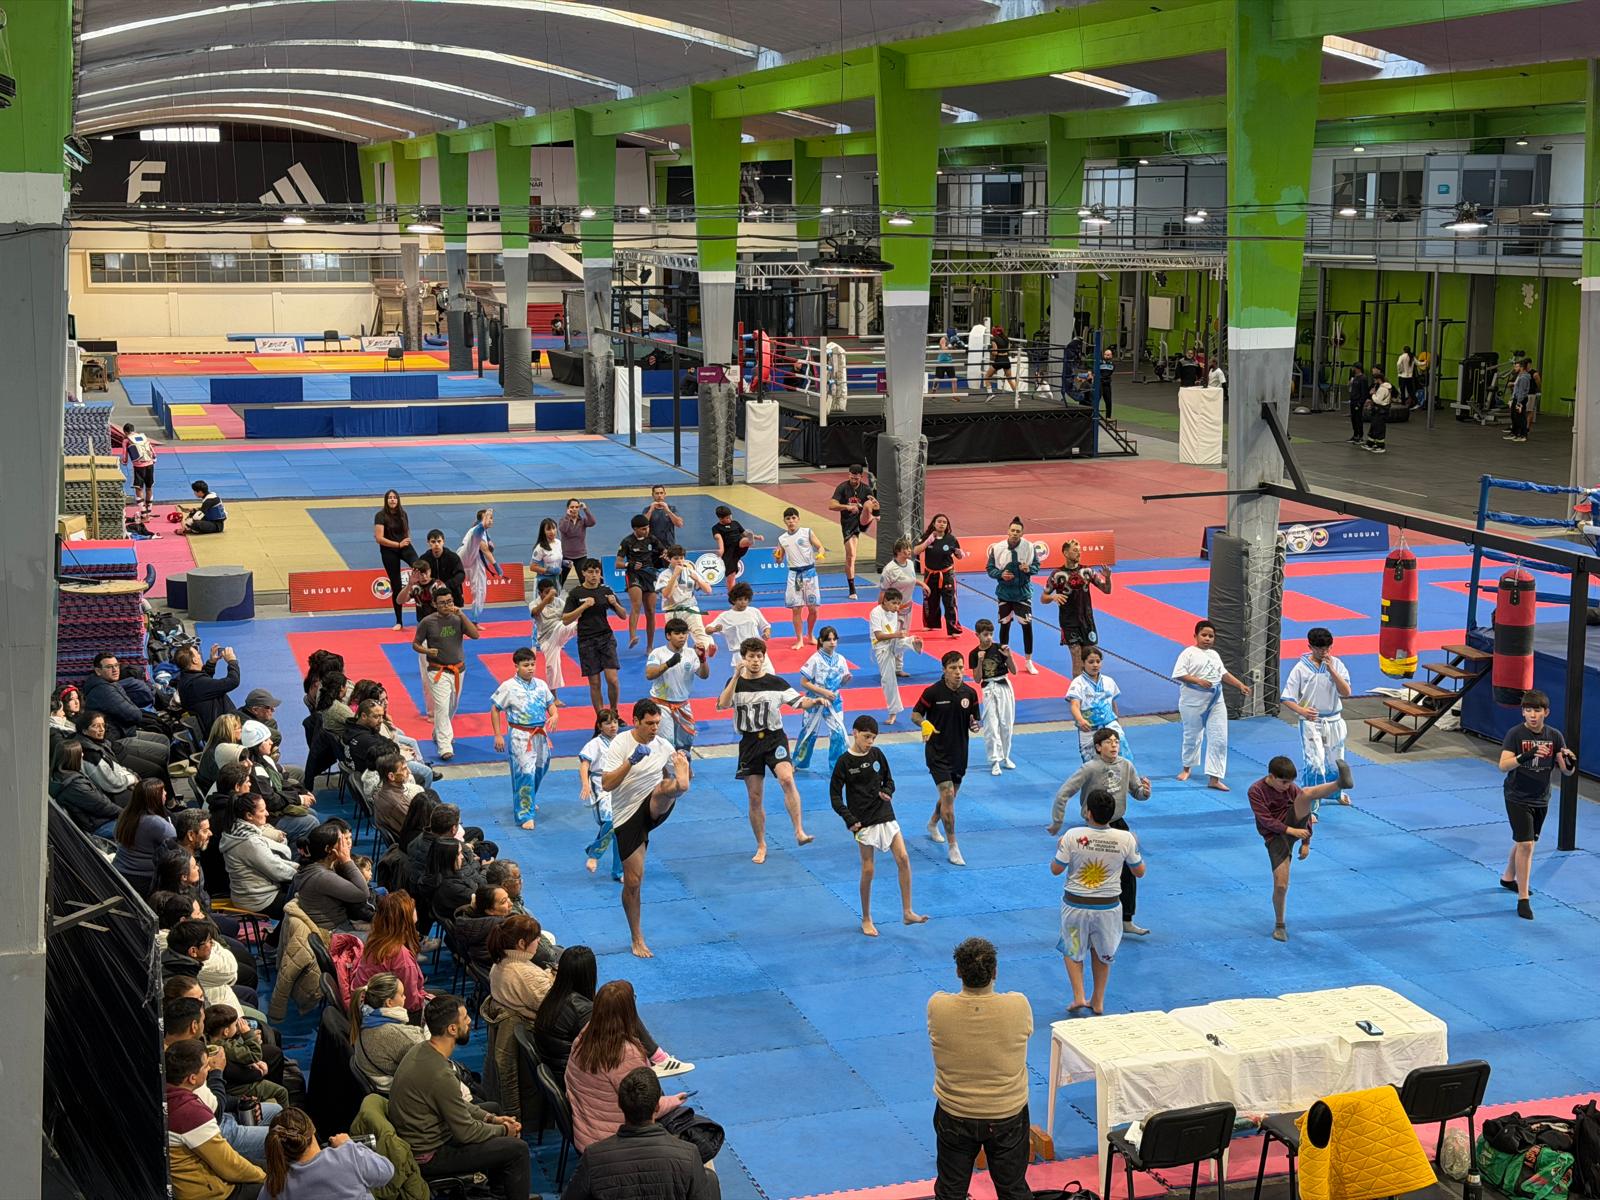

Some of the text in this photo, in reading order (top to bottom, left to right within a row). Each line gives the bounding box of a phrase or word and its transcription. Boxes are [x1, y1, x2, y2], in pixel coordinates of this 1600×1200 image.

[1342, 531, 1380, 539] URUGUAY
[465, 578, 512, 587] UGUAY
[303, 586, 353, 595] URUGUAY
